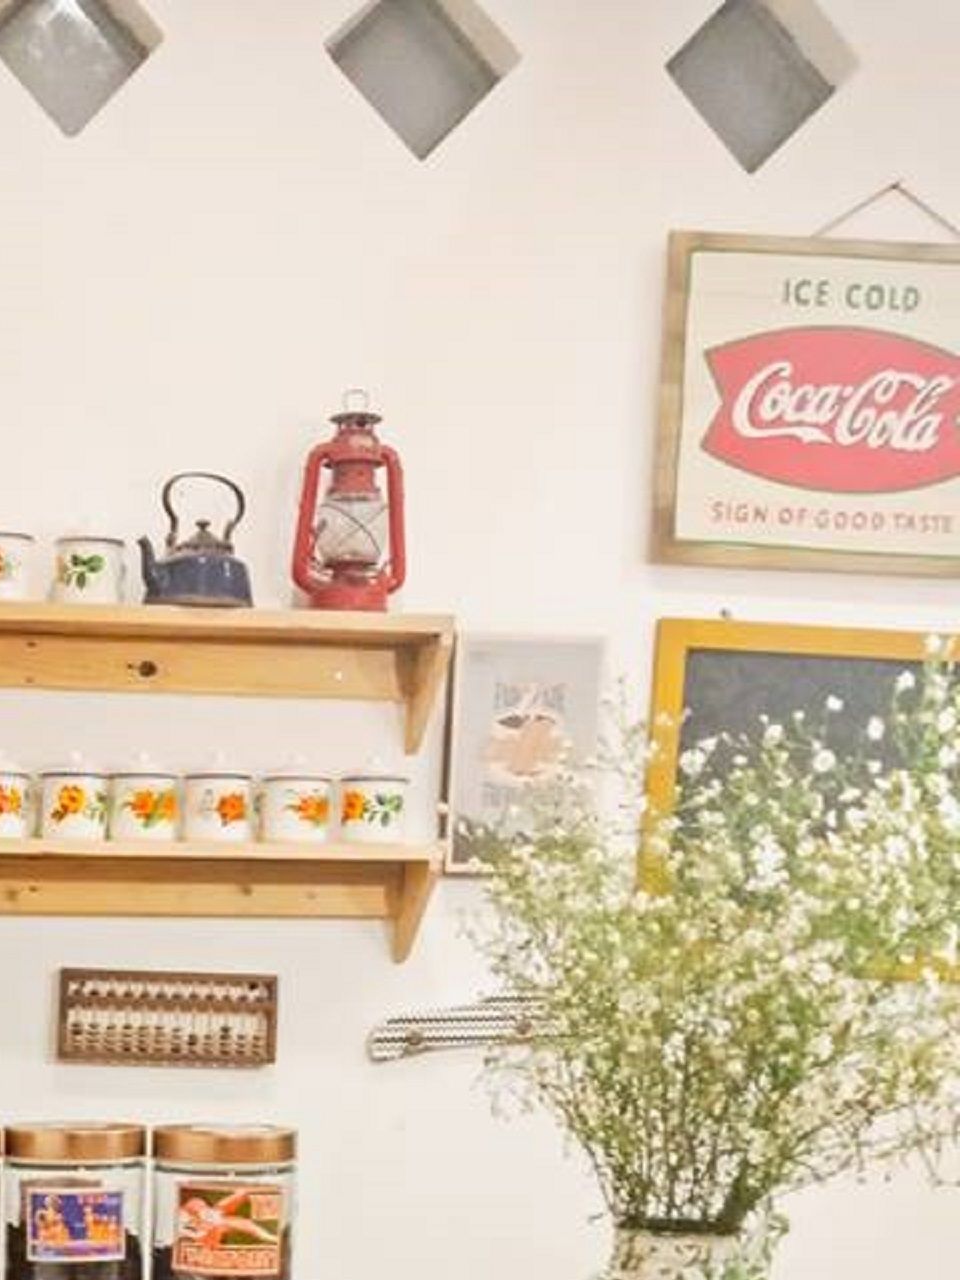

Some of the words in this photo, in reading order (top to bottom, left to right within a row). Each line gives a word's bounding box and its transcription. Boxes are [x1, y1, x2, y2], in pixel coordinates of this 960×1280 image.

[782, 279, 830, 307] ICE
[844, 283, 921, 312] COLD
[710, 501, 769, 524] SIGN
[778, 507, 807, 525] OF
[814, 509, 885, 531] GOOD
[893, 513, 955, 534] TASTE
